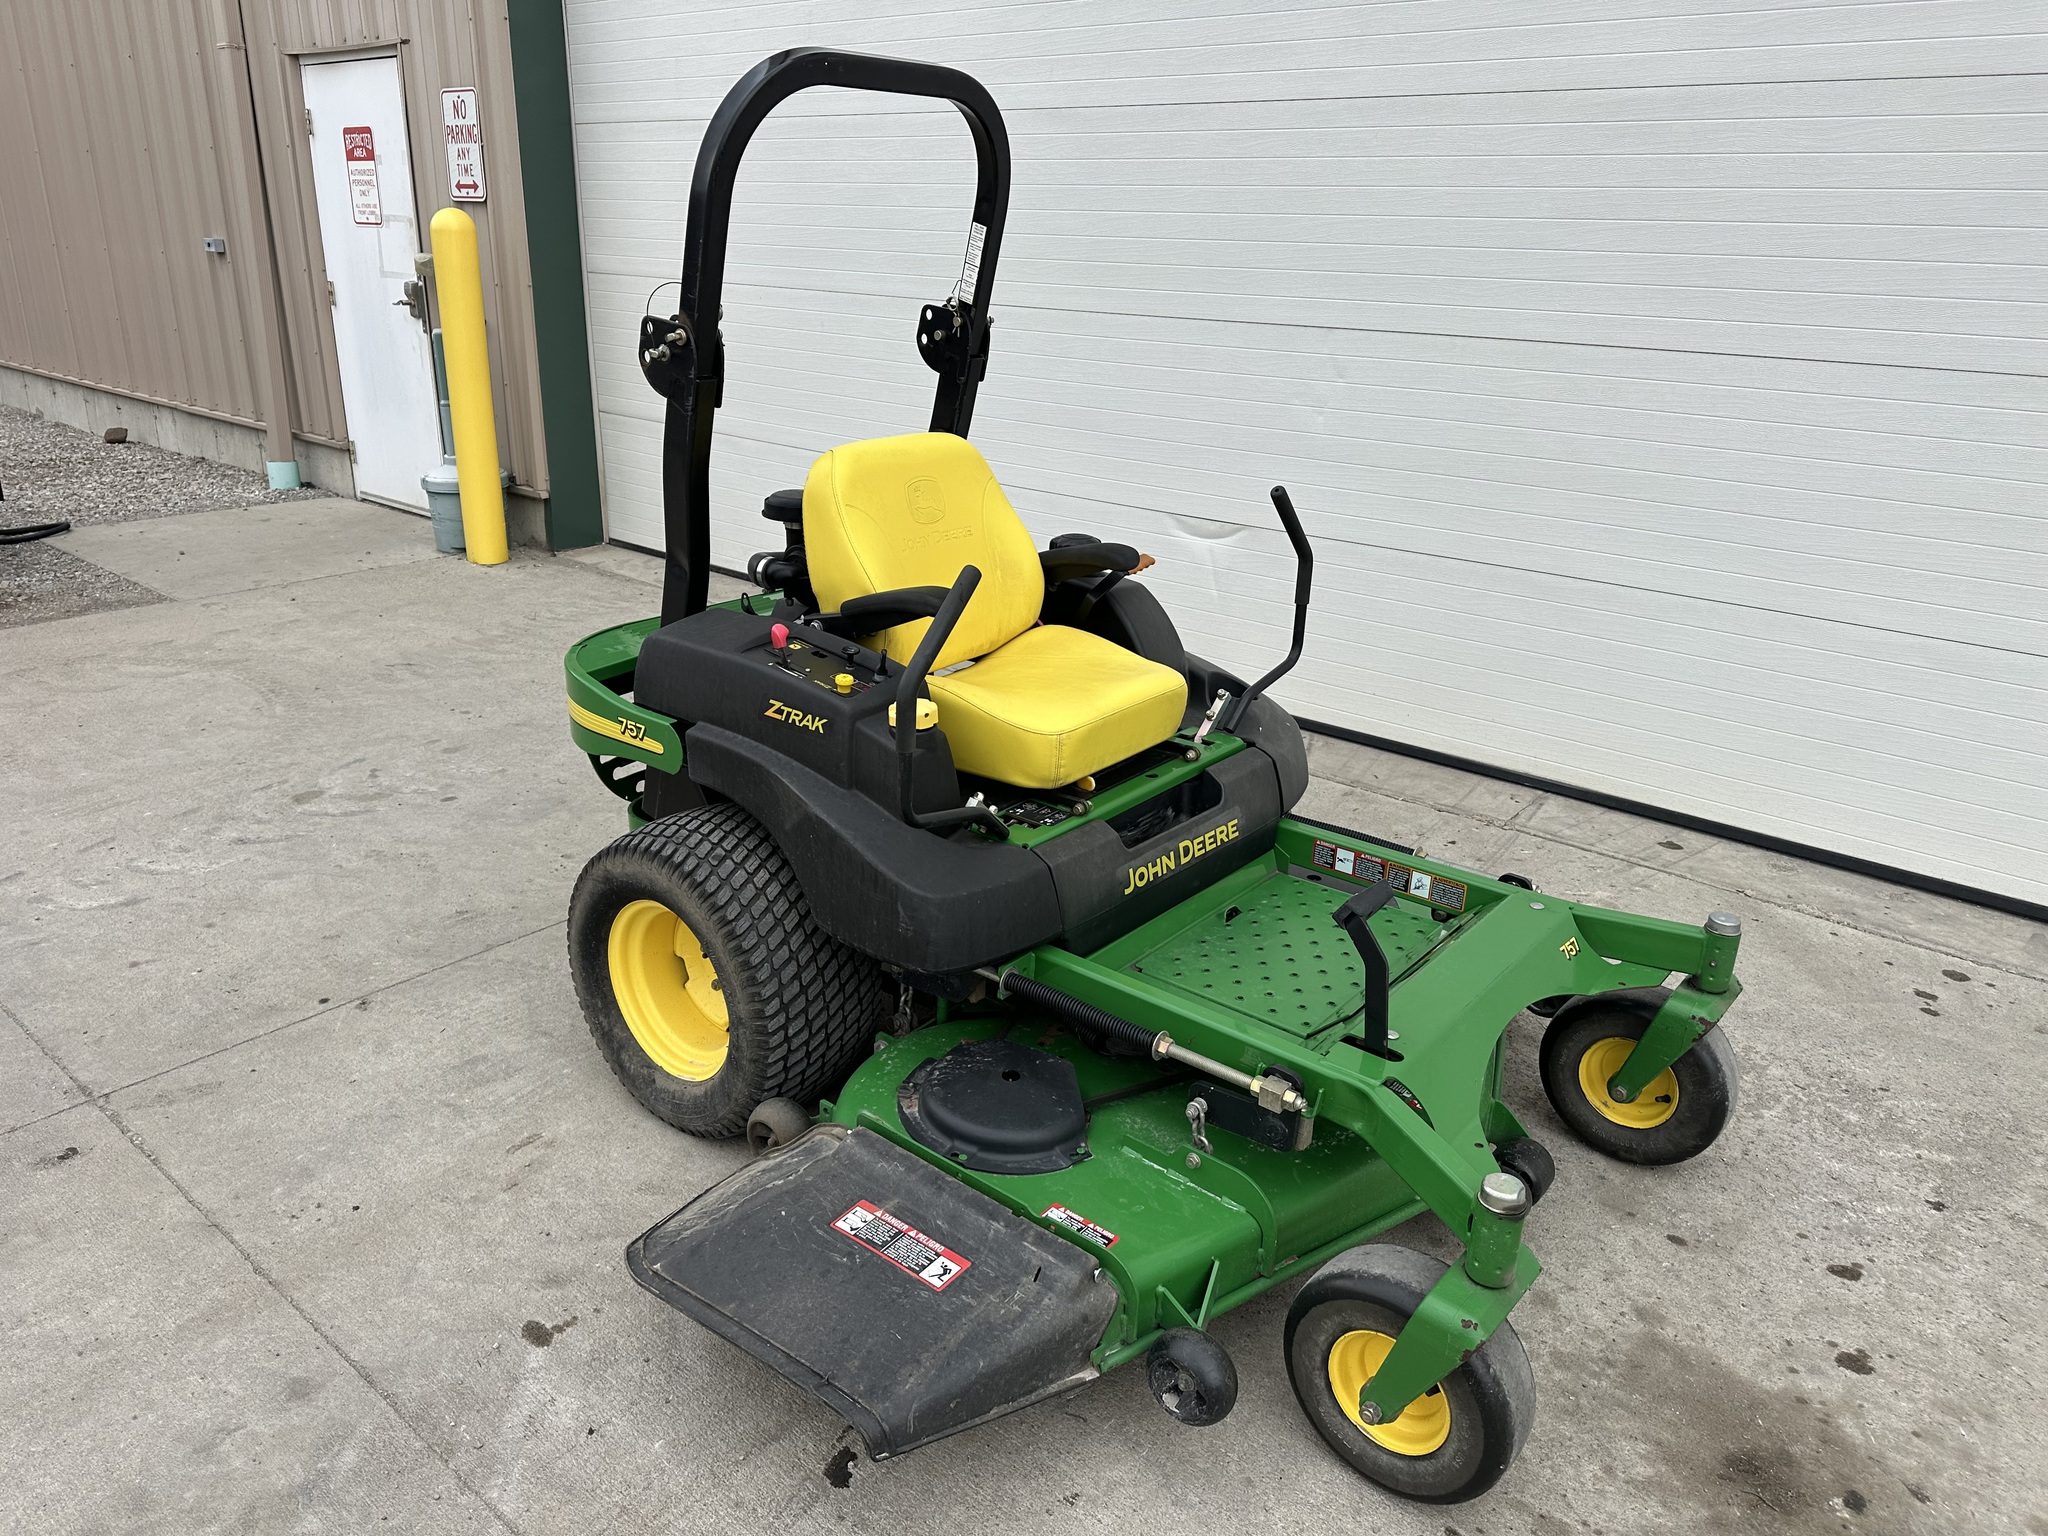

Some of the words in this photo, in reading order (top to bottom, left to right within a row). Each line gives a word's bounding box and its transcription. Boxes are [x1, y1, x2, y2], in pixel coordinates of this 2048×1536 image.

[452, 99, 467, 120] NO
[344, 133, 372, 151] RESTRICTED
[446, 123, 478, 145] PARKING
[353, 147, 367, 158] AREA
[456, 147, 471, 161] ANY
[350, 168, 375, 177] AUTHORIZED
[456, 163, 475, 177] TIME
[351, 179, 376, 187] PERSONNEL
[359, 189, 370, 197] ONLY
[901, 533, 931, 554] JOHN
[931, 525, 974, 543] DEERE
[616, 715, 647, 742] 757
[1124, 850, 1176, 896] JOHN
[1177, 818, 1240, 865] DEERE
[1559, 935, 1581, 961] 757
[880, 1213, 909, 1231] DANGER
[914, 1232, 946, 1252] PELIGRO
[1064, 1209, 1085, 1222] DANGER
[1093, 1225, 1115, 1239] PELIGRO
